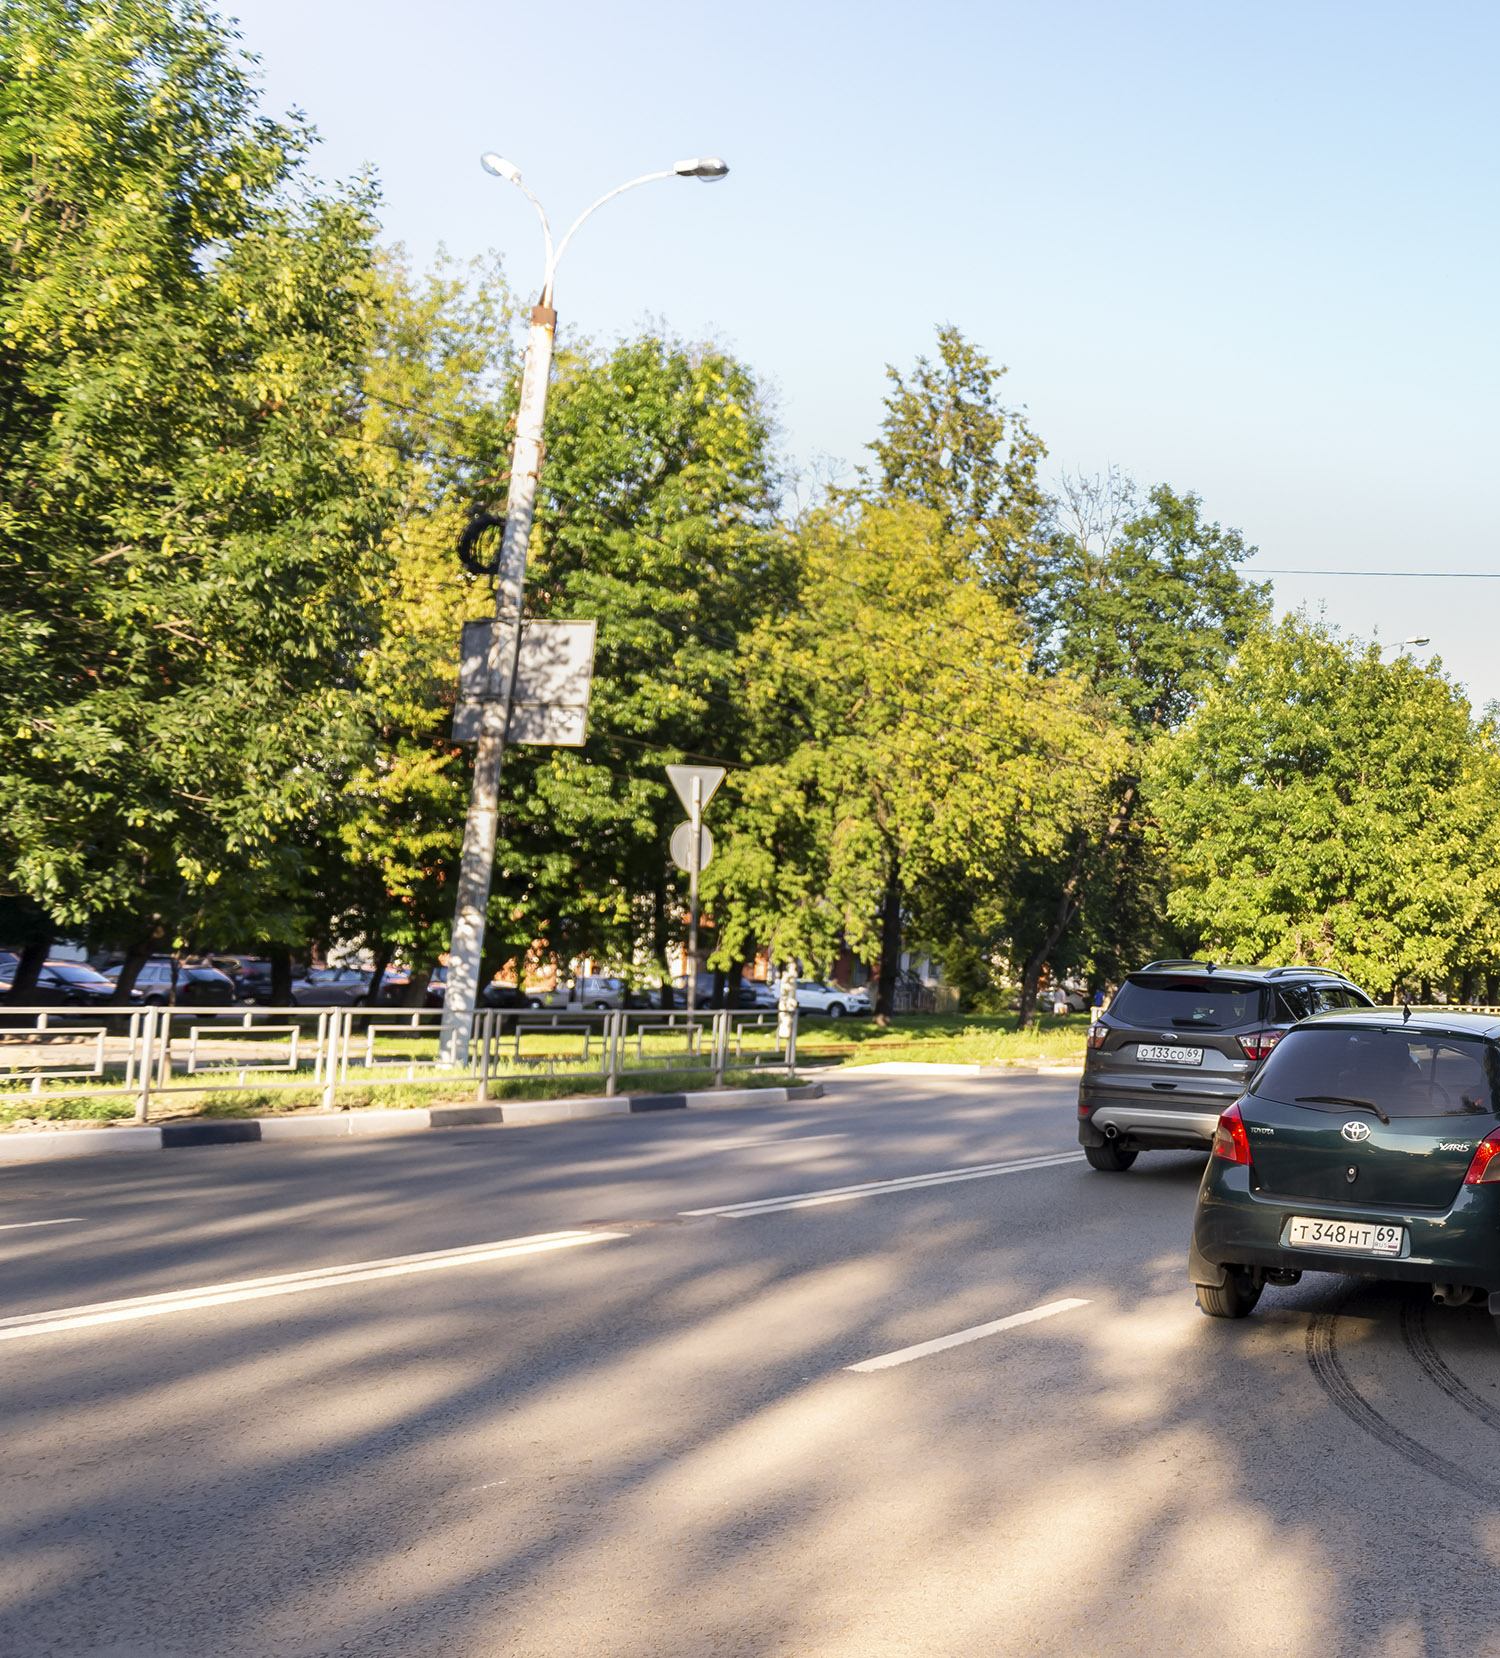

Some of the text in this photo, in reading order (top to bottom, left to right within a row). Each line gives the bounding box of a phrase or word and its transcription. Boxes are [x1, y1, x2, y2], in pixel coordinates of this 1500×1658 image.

[1187, 1048, 1199, 1058] 69
[1250, 1126, 1275, 1135] TOYOTA
[1440, 1142, 1470, 1152] YARIS
[1376, 1227, 1395, 1242] 69
